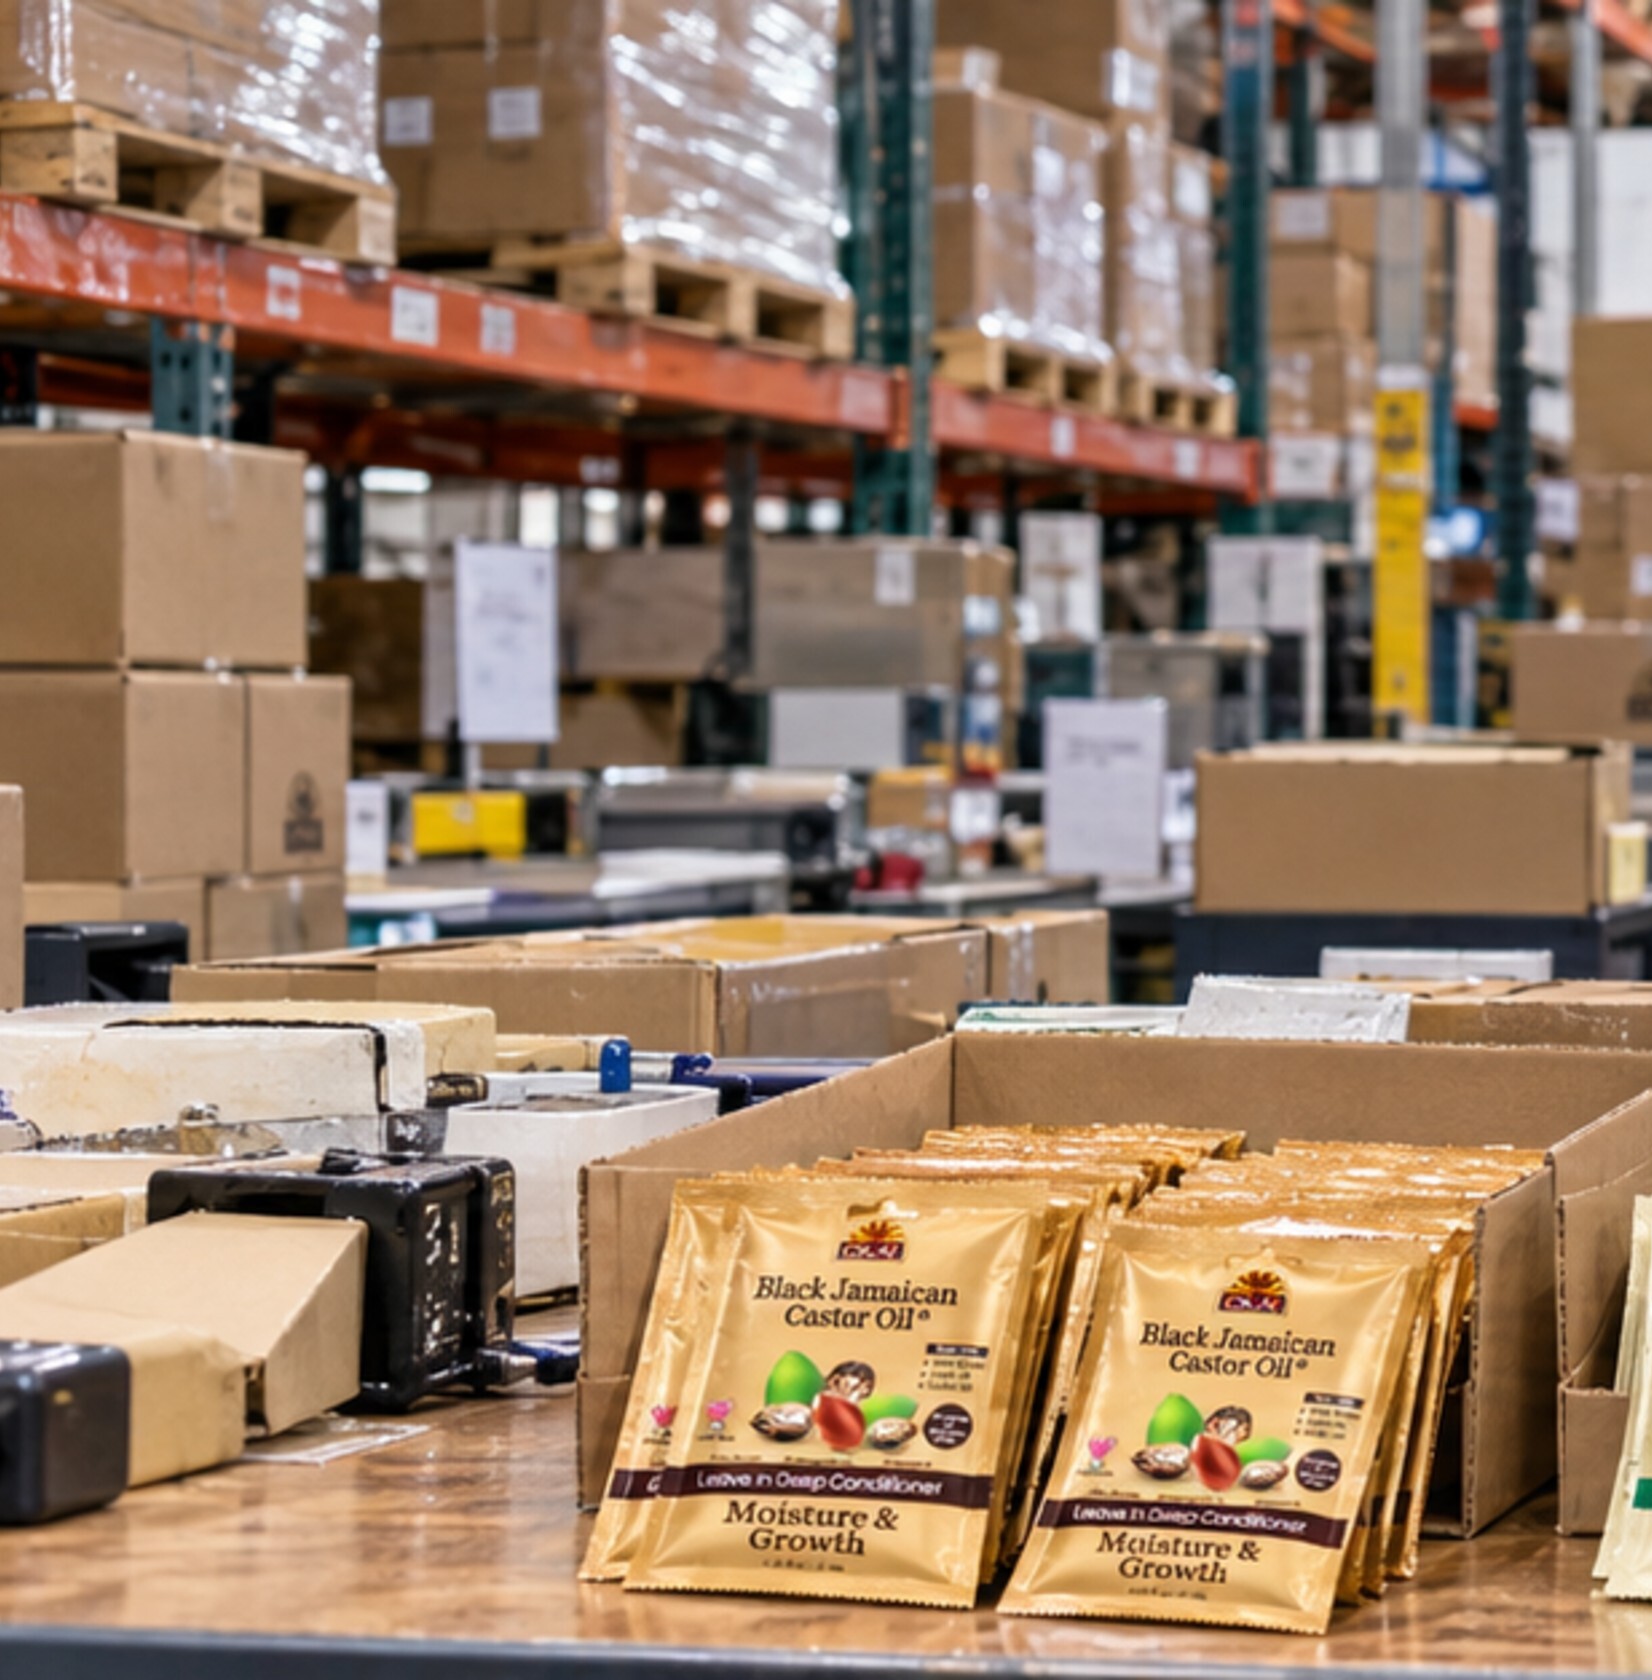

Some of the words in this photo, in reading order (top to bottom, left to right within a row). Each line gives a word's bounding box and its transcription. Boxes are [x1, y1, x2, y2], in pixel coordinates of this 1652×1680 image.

[754, 1275, 826, 1301] Black
[830, 1277, 959, 1306] Jamaican
[1140, 1322, 1209, 1348] Black
[1213, 1326, 1337, 1357] Jamaican
[1168, 1351, 1250, 1378] Castor
[722, 1500, 869, 1529] Moisture
[873, 1507, 899, 1531] &
[748, 1529, 866, 1556] Growth
[1236, 1538, 1262, 1563] &
[1117, 1556, 1228, 1586] Growth
